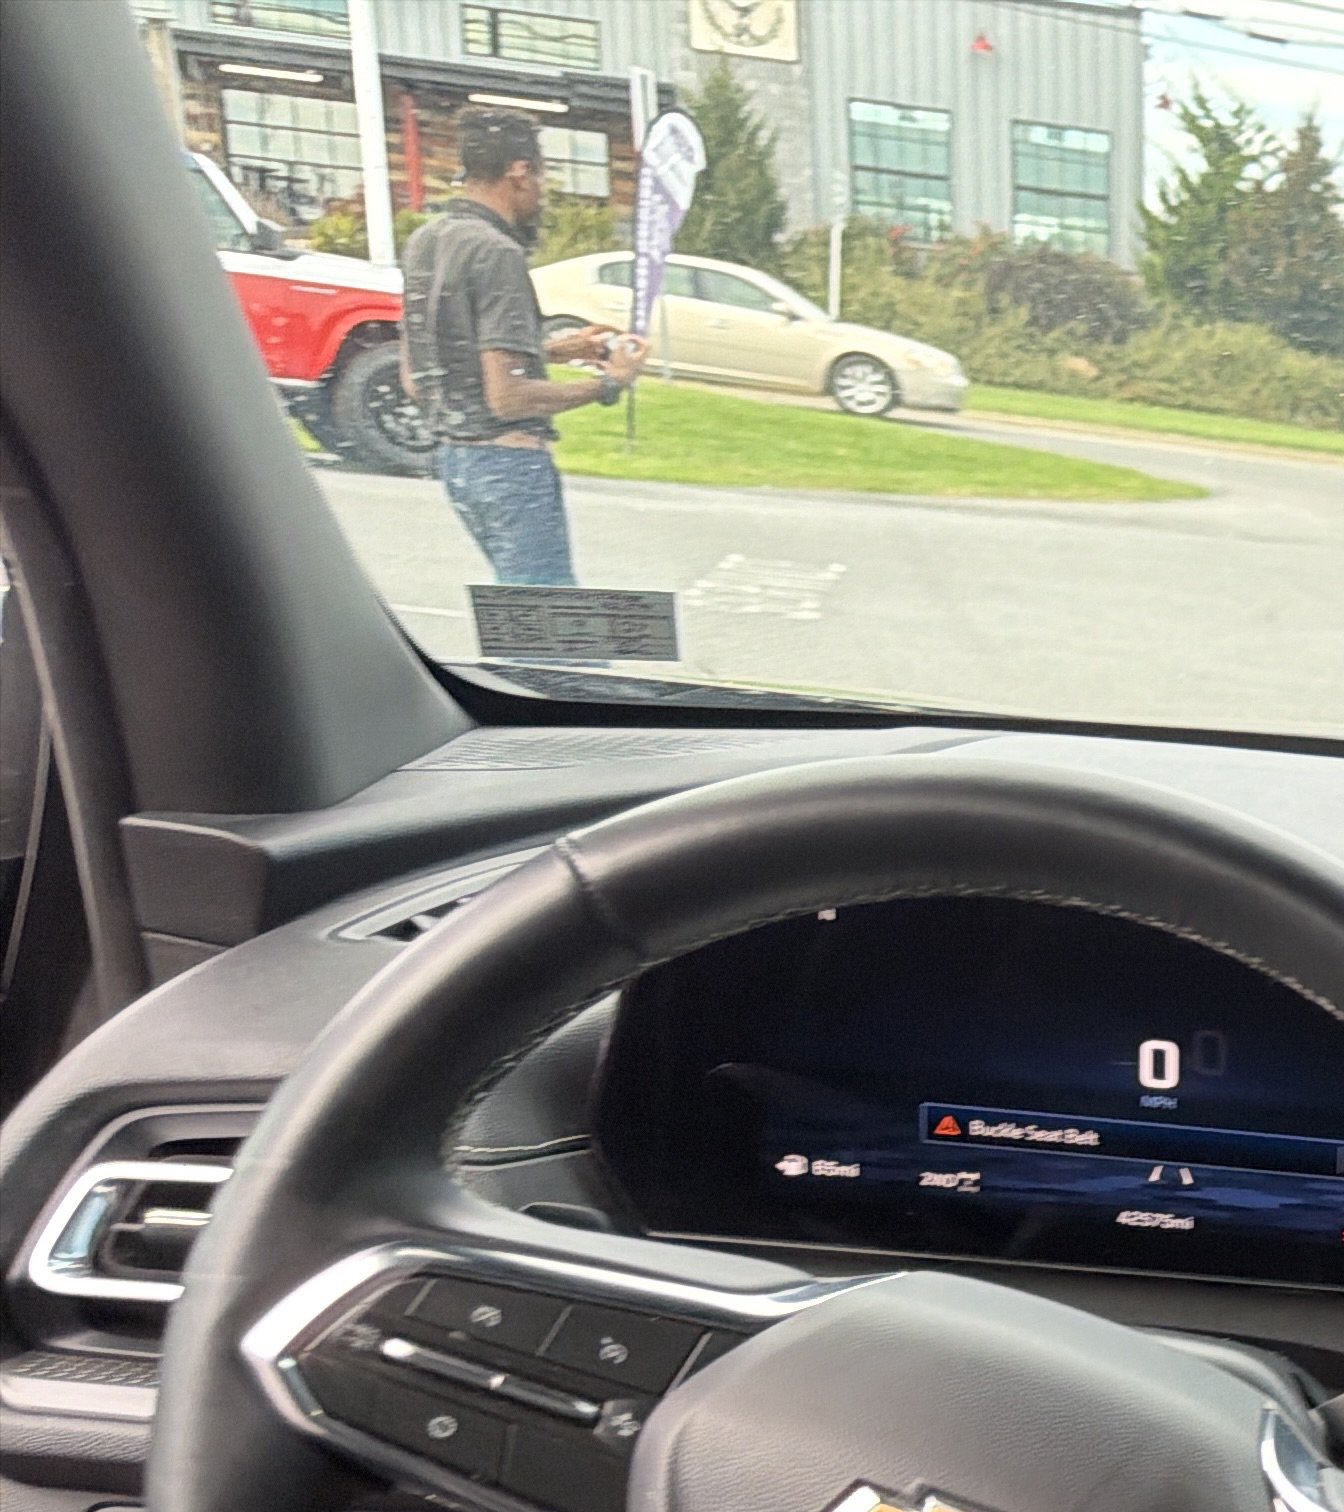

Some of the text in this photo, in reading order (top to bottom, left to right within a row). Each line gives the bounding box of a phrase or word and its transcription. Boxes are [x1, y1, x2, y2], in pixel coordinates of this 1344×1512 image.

[1138, 1039, 1180, 1089] 0
[968, 1119, 1101, 1146] Buckle Seat Belt
